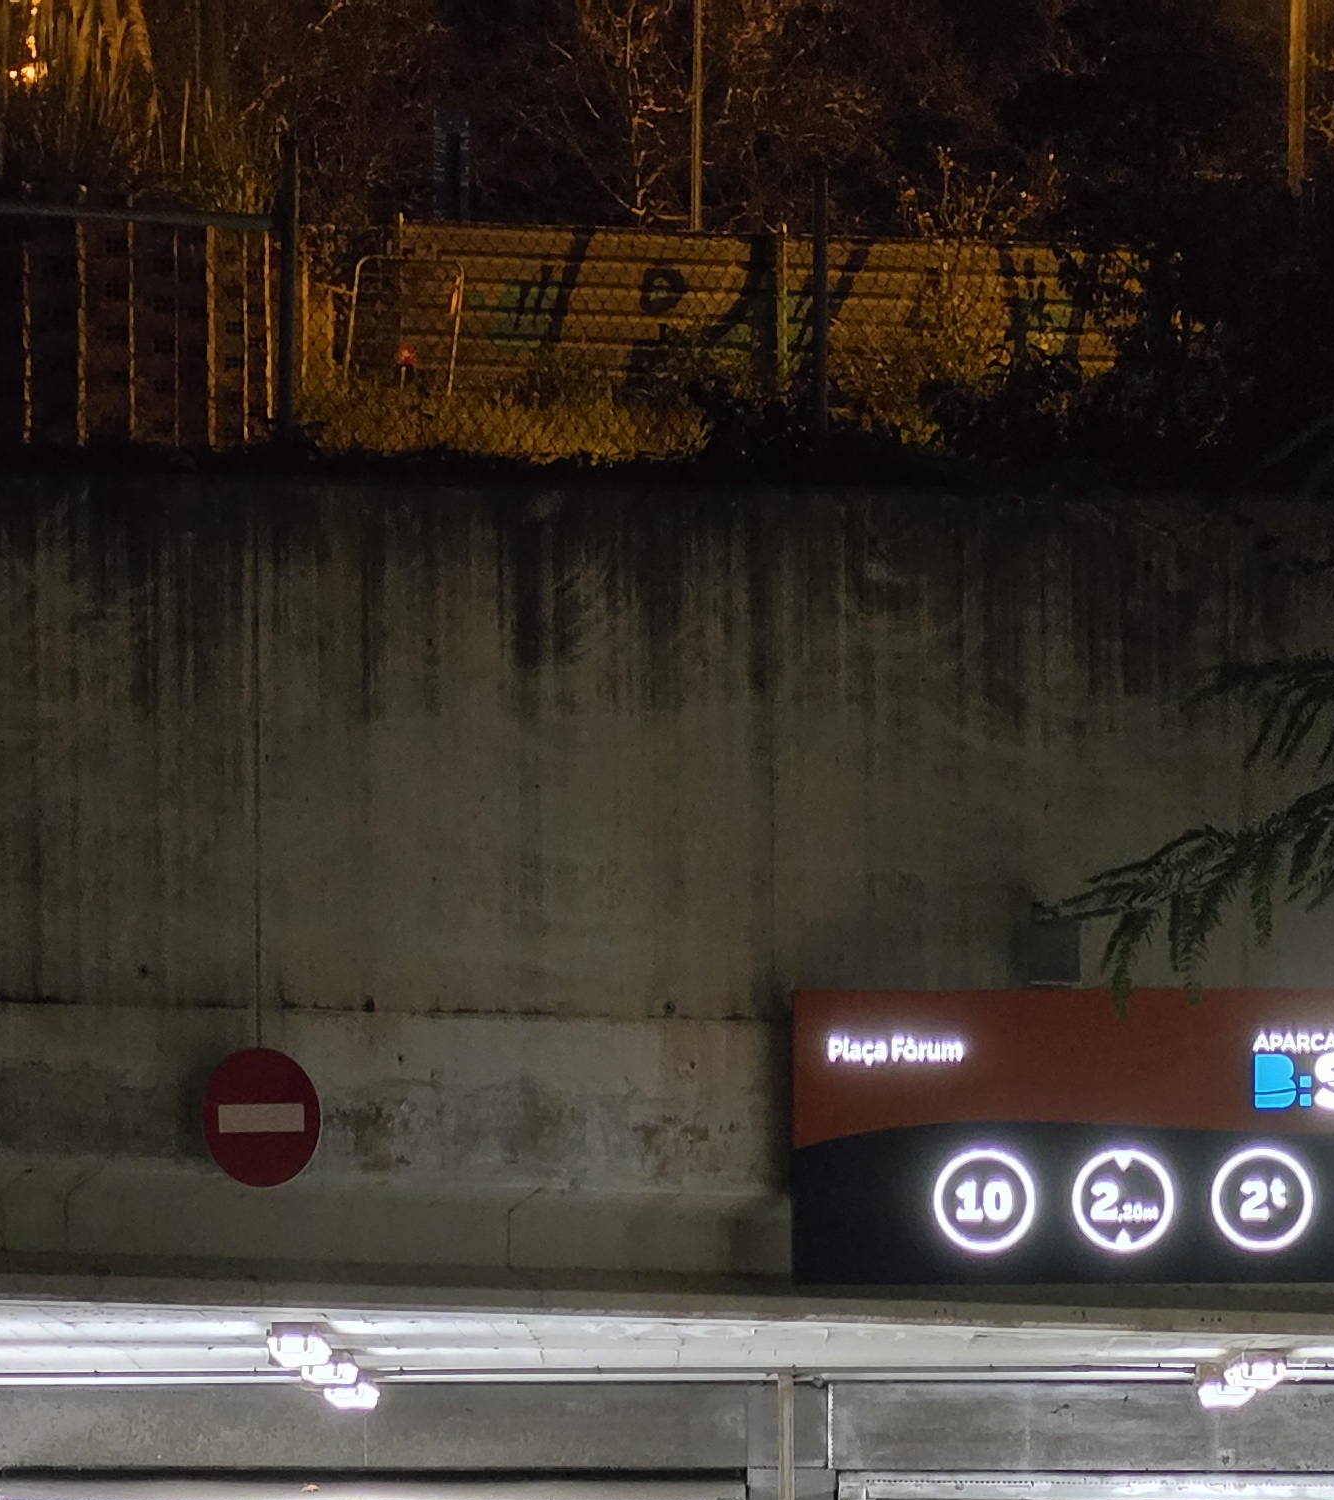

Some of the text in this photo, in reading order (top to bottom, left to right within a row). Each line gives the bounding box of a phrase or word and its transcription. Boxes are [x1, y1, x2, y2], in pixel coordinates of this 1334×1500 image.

[828, 1035, 964, 1066] Plaça Fòrum
[955, 1178, 1013, 1222] 10
